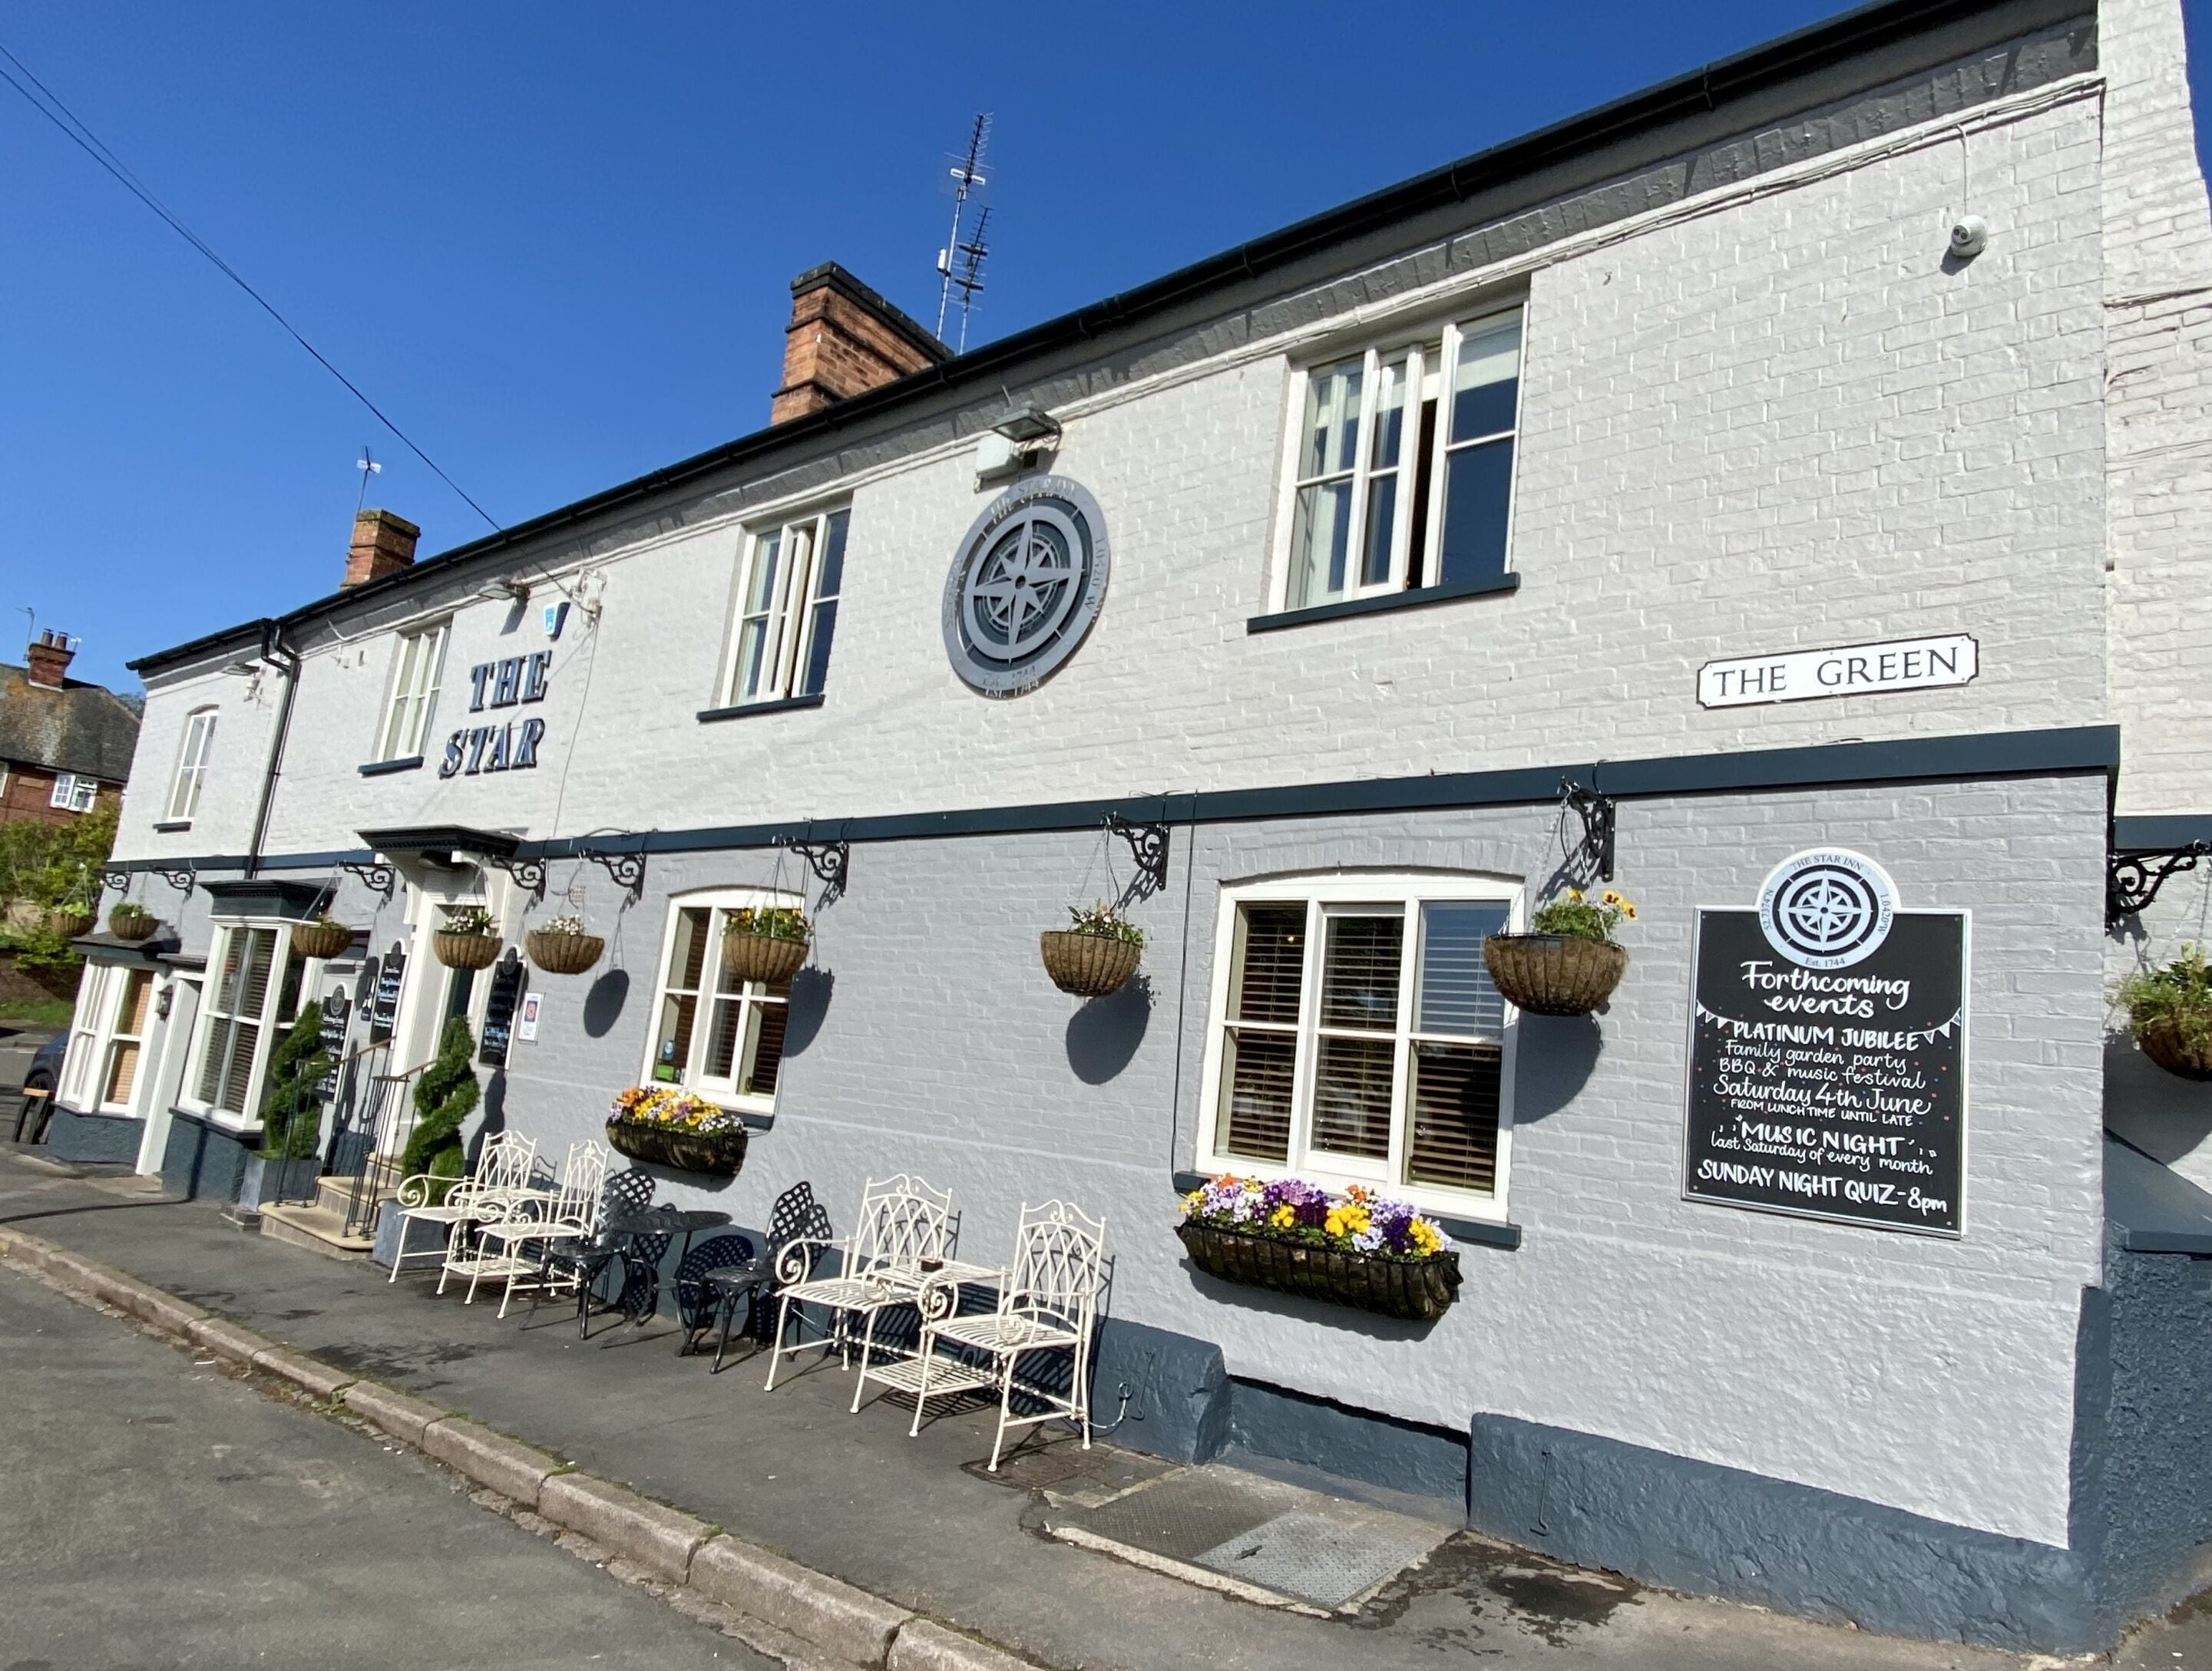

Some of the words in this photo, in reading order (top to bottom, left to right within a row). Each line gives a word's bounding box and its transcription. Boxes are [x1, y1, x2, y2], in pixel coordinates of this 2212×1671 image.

[469, 649, 552, 714] THE
[1712, 664, 1787, 696] THE
[1817, 646, 1959, 686] GREEN
[438, 718, 545, 780] STAR
[1790, 856, 1812, 870] THE
[1814, 854, 1841, 864] STAR
[1843, 857, 1864, 870] INN
[1805, 957, 1821, 967] Est.
[1823, 957, 1846, 967] 1744
[1740, 960, 1910, 1010] Forthcoming
[1763, 994, 1874, 1019] events
[1733, 1022, 1834, 1045] PLATINUM
[1841, 1029, 1919, 1052] JUBILEE
[1725, 1039, 1781, 1064] Family
[1786, 1047, 1844, 1067] garden
[1853, 1053, 1906, 1073] party
[1719, 1058, 1757, 1075] BBQ
[1762, 1062, 1780, 1077] &
[1787, 1066, 1838, 1082] music
[1842, 1065, 1926, 1090] festival
[1713, 1074, 1811, 1106] Saturday
[1815, 1083, 1863, 1109] 4th
[1866, 1088, 1932, 1115] June
[1731, 1098, 1764, 1111] FROM
[1841, 1110, 1878, 1123] UNTIL
[1882, 1114, 1913, 1127] LATE
[1711, 1130, 1741, 1150] last
[1743, 1138, 1807, 1164] Saturday
[1809, 1147, 1826, 1165] of
[1827, 1151, 1870, 1173] every
[1879, 1158, 1934, 1175] month
[1741, 1121, 1817, 1147] MUSIC
[1822, 1131, 1906, 1156] NIGHT
[1697, 1159, 1775, 1188] SUNDAY
[1779, 1171, 1843, 1197] NIGHT
